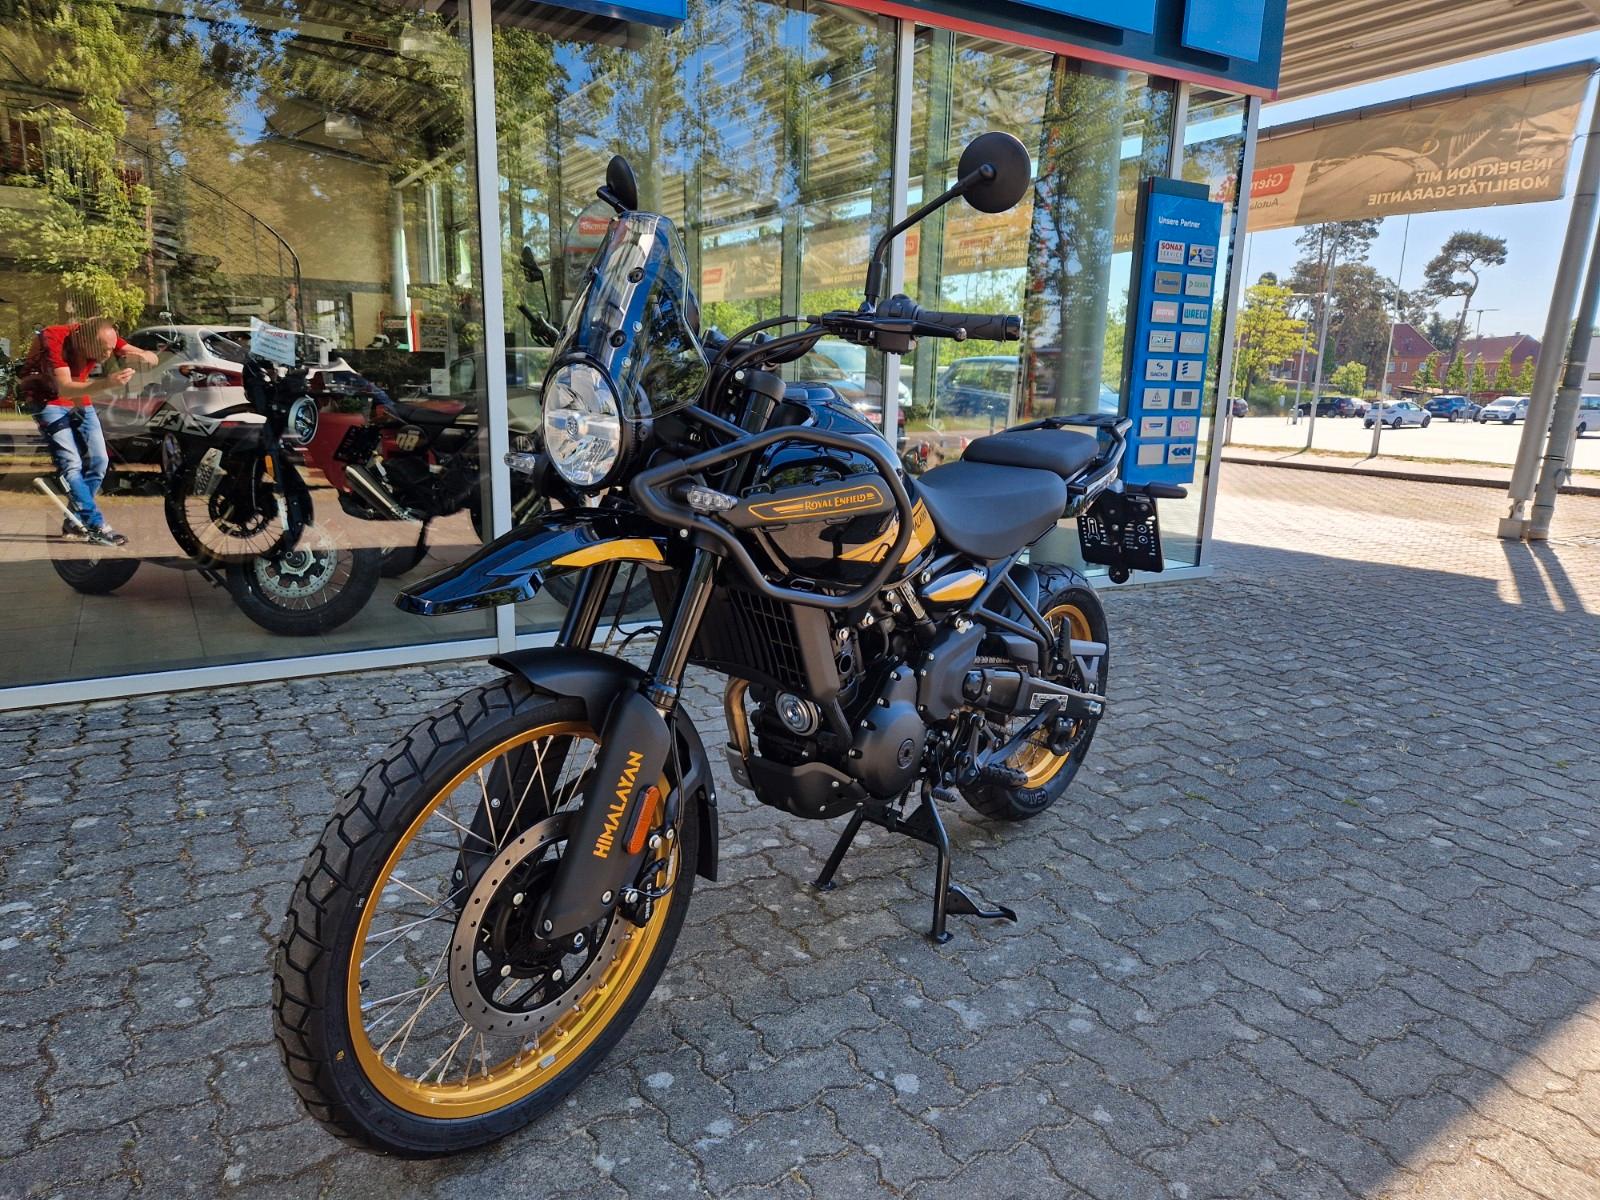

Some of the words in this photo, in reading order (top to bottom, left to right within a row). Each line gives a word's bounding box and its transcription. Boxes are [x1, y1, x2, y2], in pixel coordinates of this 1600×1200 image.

[1158, 215, 1179, 226] Unsere
[1180, 218, 1201, 229] Partner
[1161, 242, 1184, 251] SONAX
[1159, 250, 1183, 258] SERVICE
[804, 498, 834, 511] ROYAL
[834, 493, 867, 507] ENFIELD
[592, 750, 644, 859] HIMALAYAN
